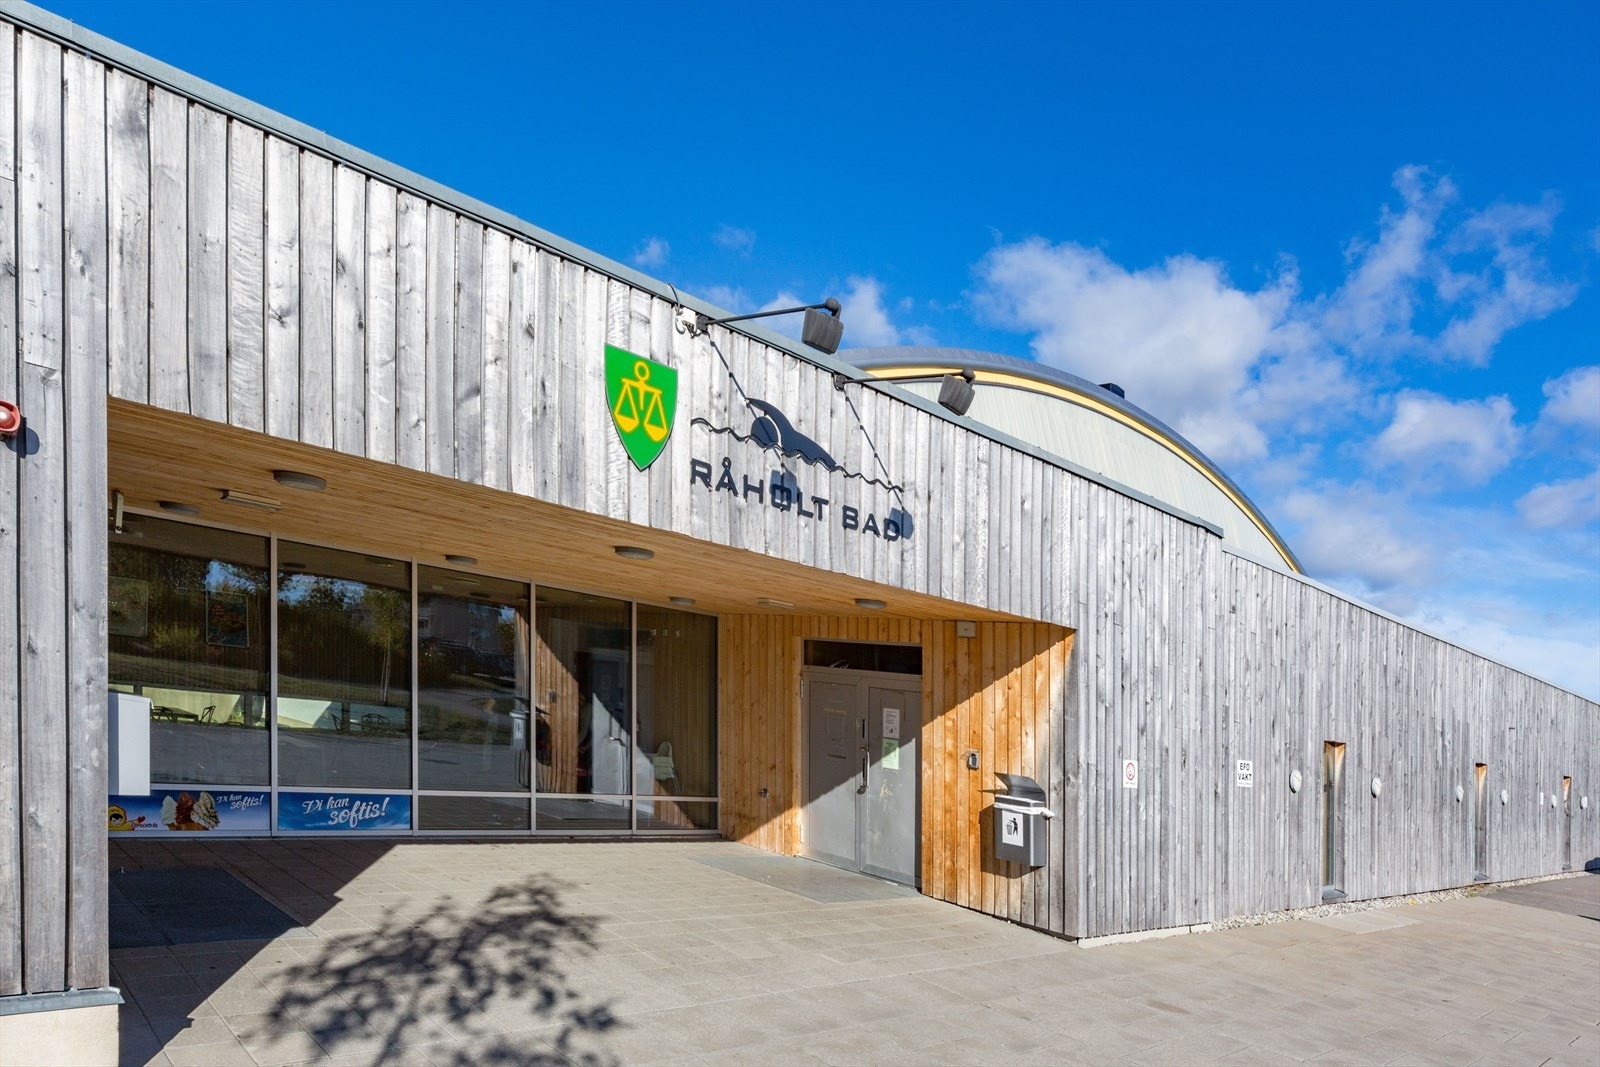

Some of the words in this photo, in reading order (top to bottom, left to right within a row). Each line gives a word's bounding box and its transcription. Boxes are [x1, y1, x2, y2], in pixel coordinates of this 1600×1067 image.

[690, 457, 829, 522] RÅHOLT
[842, 504, 901, 542] BAD
[1237, 773, 1252, 781] VAKT
[230, 794, 265, 811] softis!
[302, 799, 324, 814] Vi
[326, 796, 350, 810] kan
[327, 797, 390, 828] softis!
